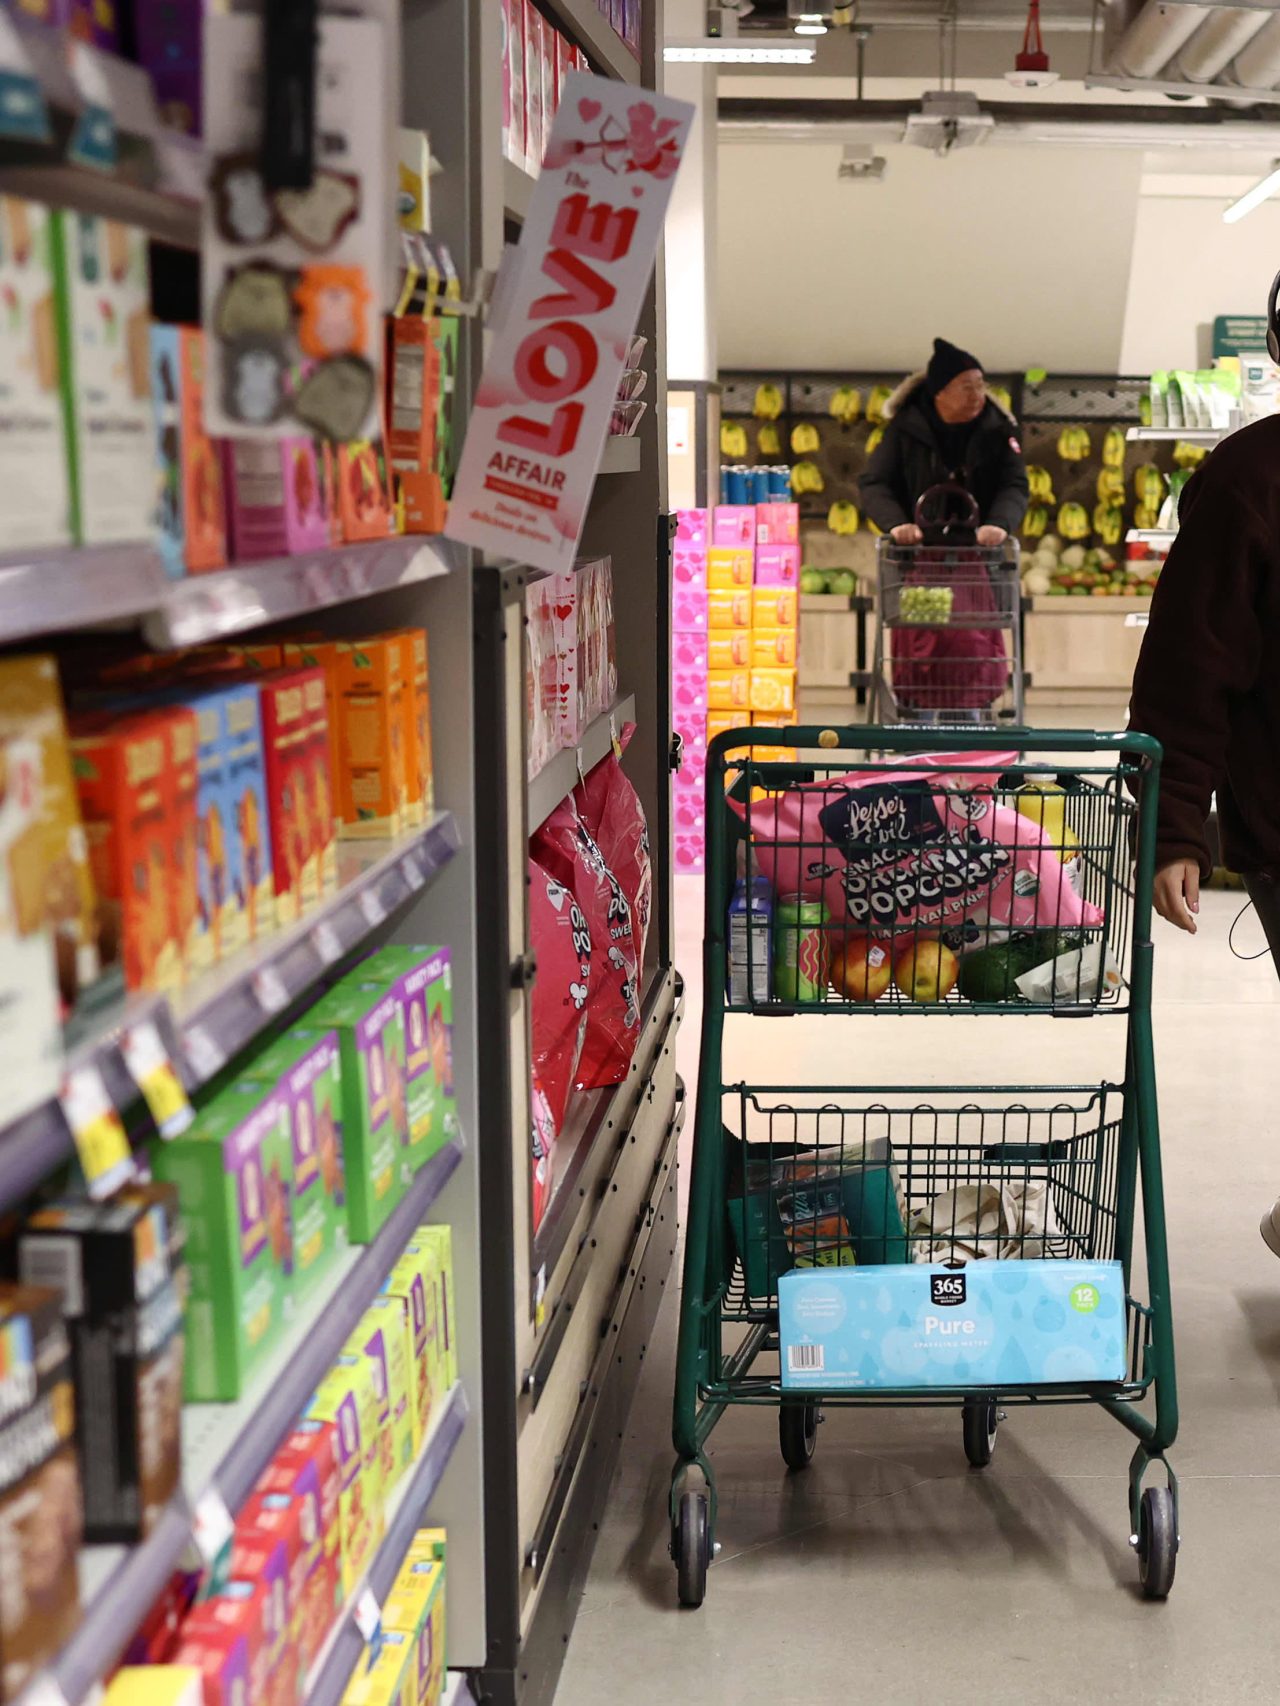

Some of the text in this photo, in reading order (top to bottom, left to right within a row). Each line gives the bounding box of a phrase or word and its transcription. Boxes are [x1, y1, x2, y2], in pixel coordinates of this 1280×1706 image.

[496, 192, 639, 458] LOVE
[487, 451, 567, 491] AFFAIR
[848, 842, 1010, 920] POPCORN
[933, 1278, 963, 1295] 365
[1075, 1287, 1094, 1302] 12
[925, 1316, 975, 1335] Pure
